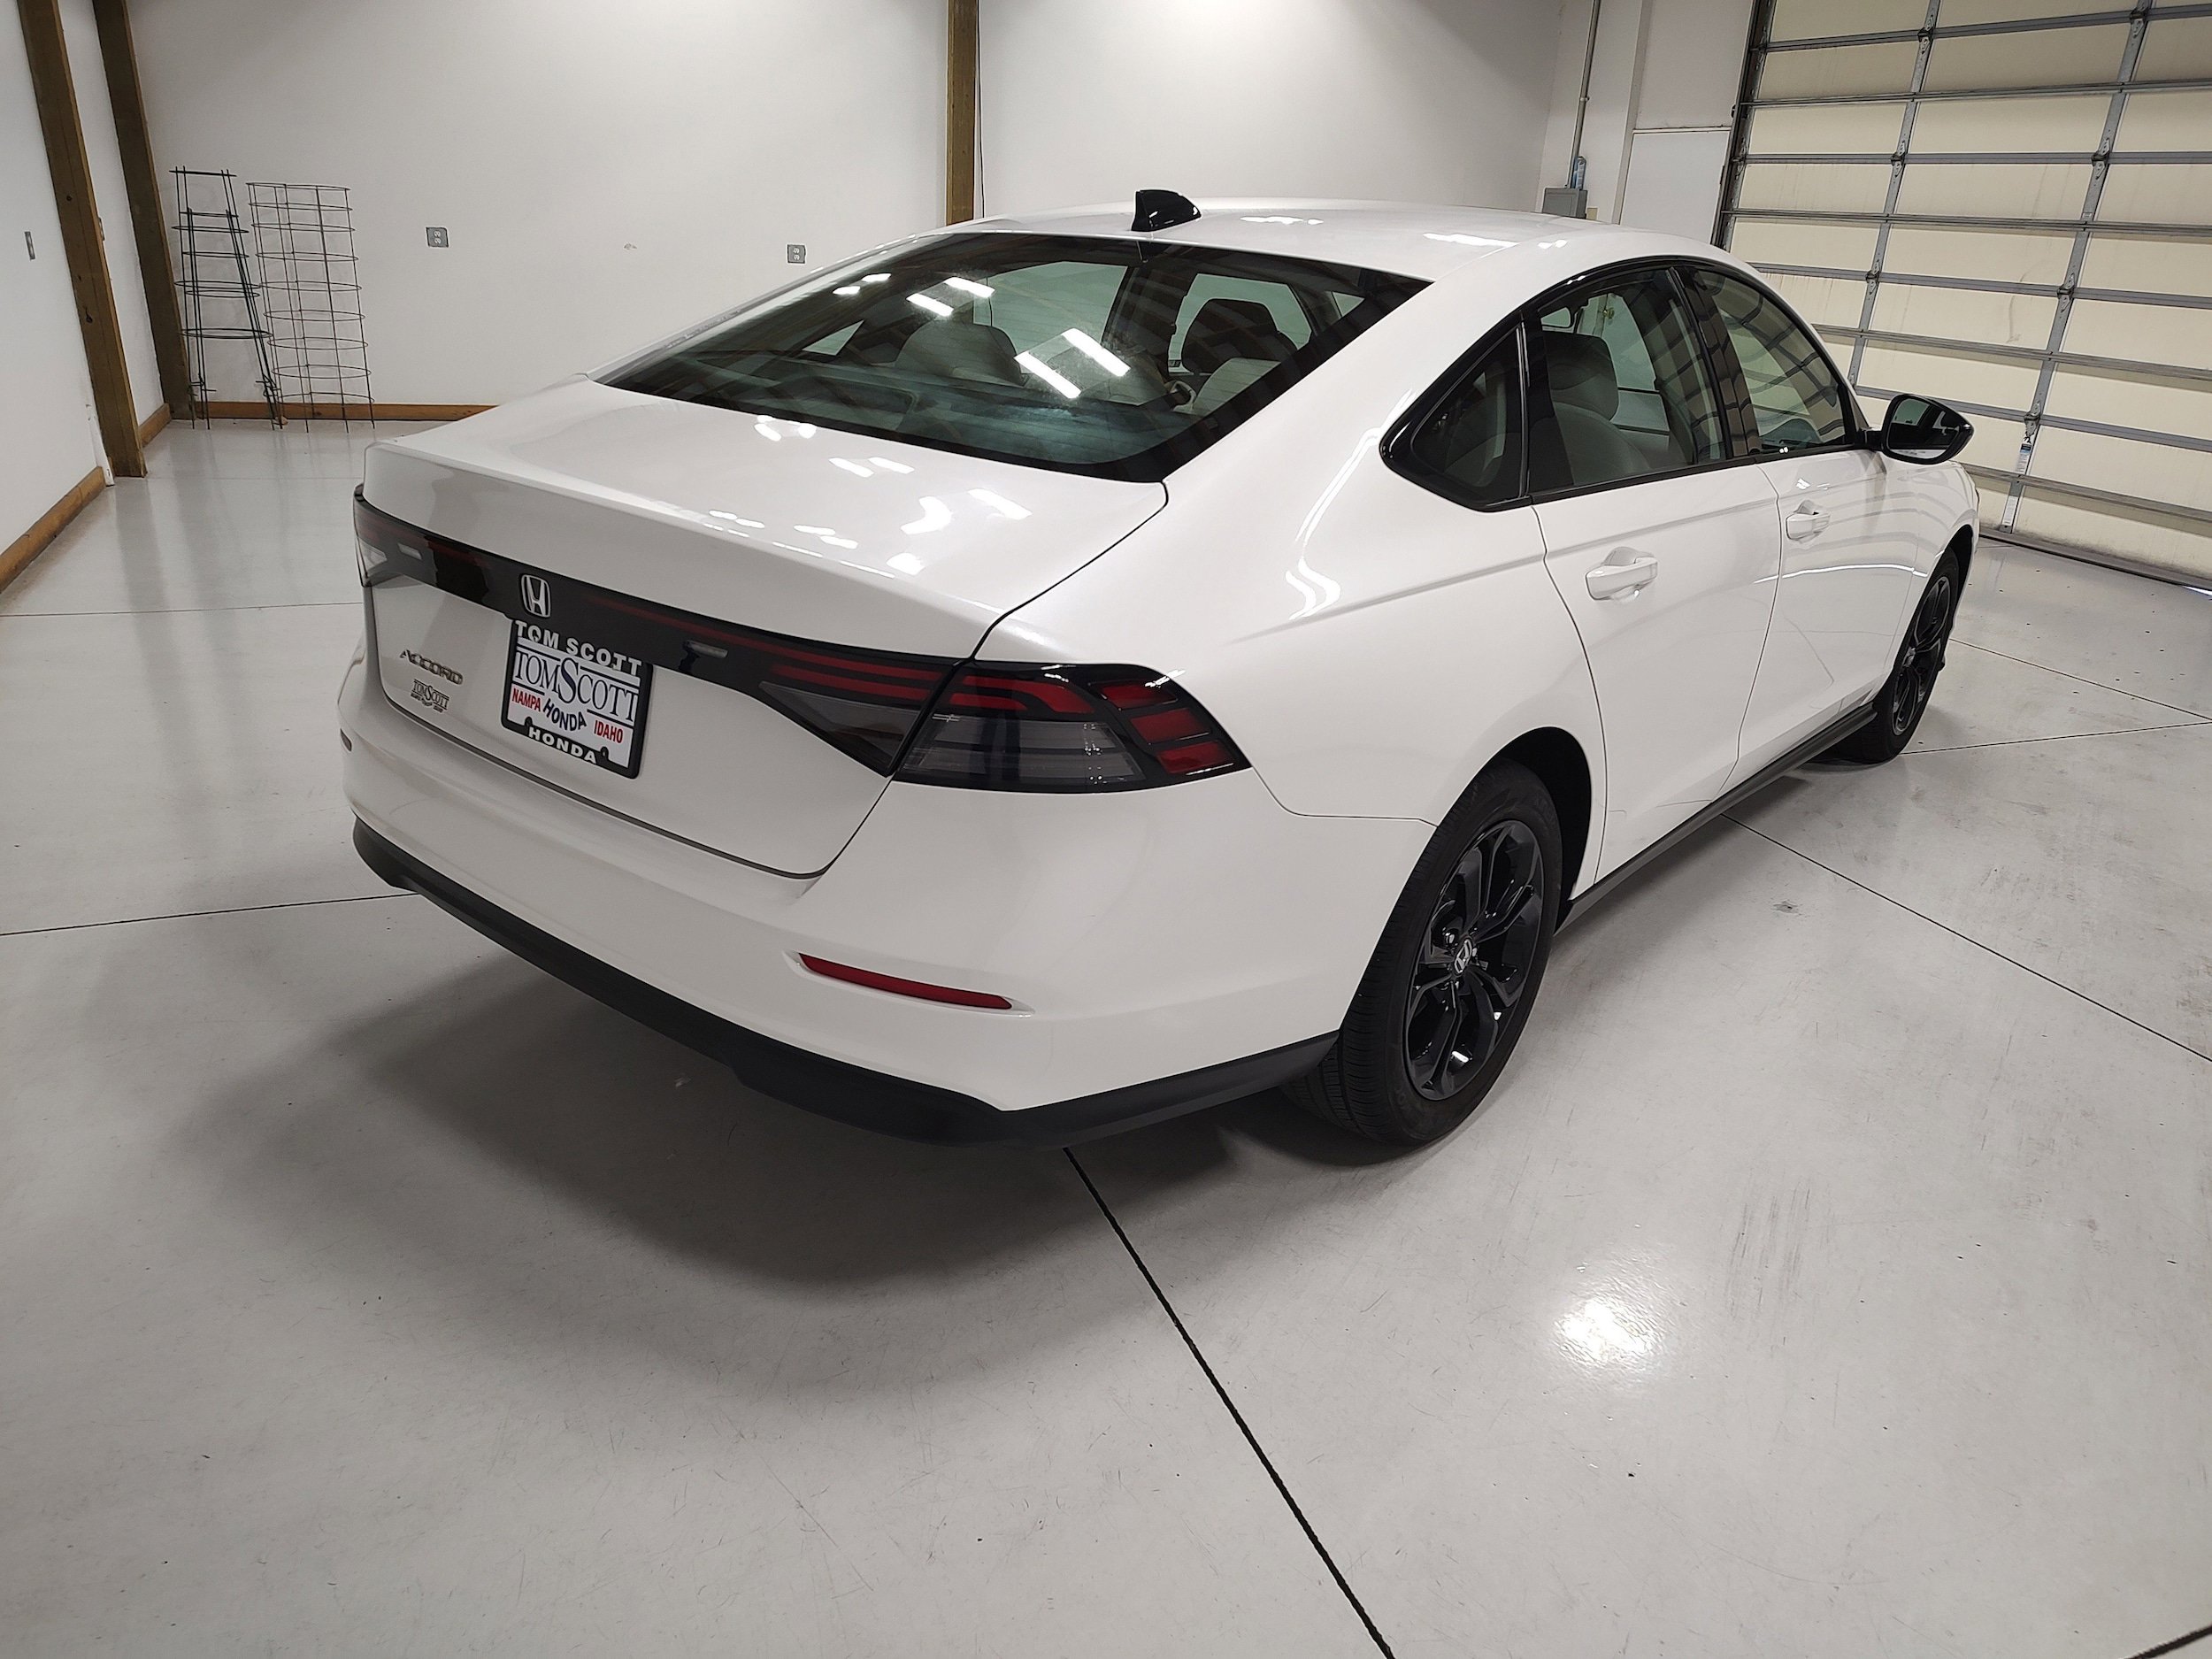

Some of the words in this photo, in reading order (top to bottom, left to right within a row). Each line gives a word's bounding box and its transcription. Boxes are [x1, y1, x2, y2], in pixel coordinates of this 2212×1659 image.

[399, 649, 463, 685] ACCORD
[515, 620, 559, 649] TOM
[566, 638, 642, 676] SCOTT
[511, 688, 541, 712] NAMPA
[542, 698, 588, 732] HONDA
[594, 720, 624, 743] IDAHO
[528, 726, 597, 764] HONDA
